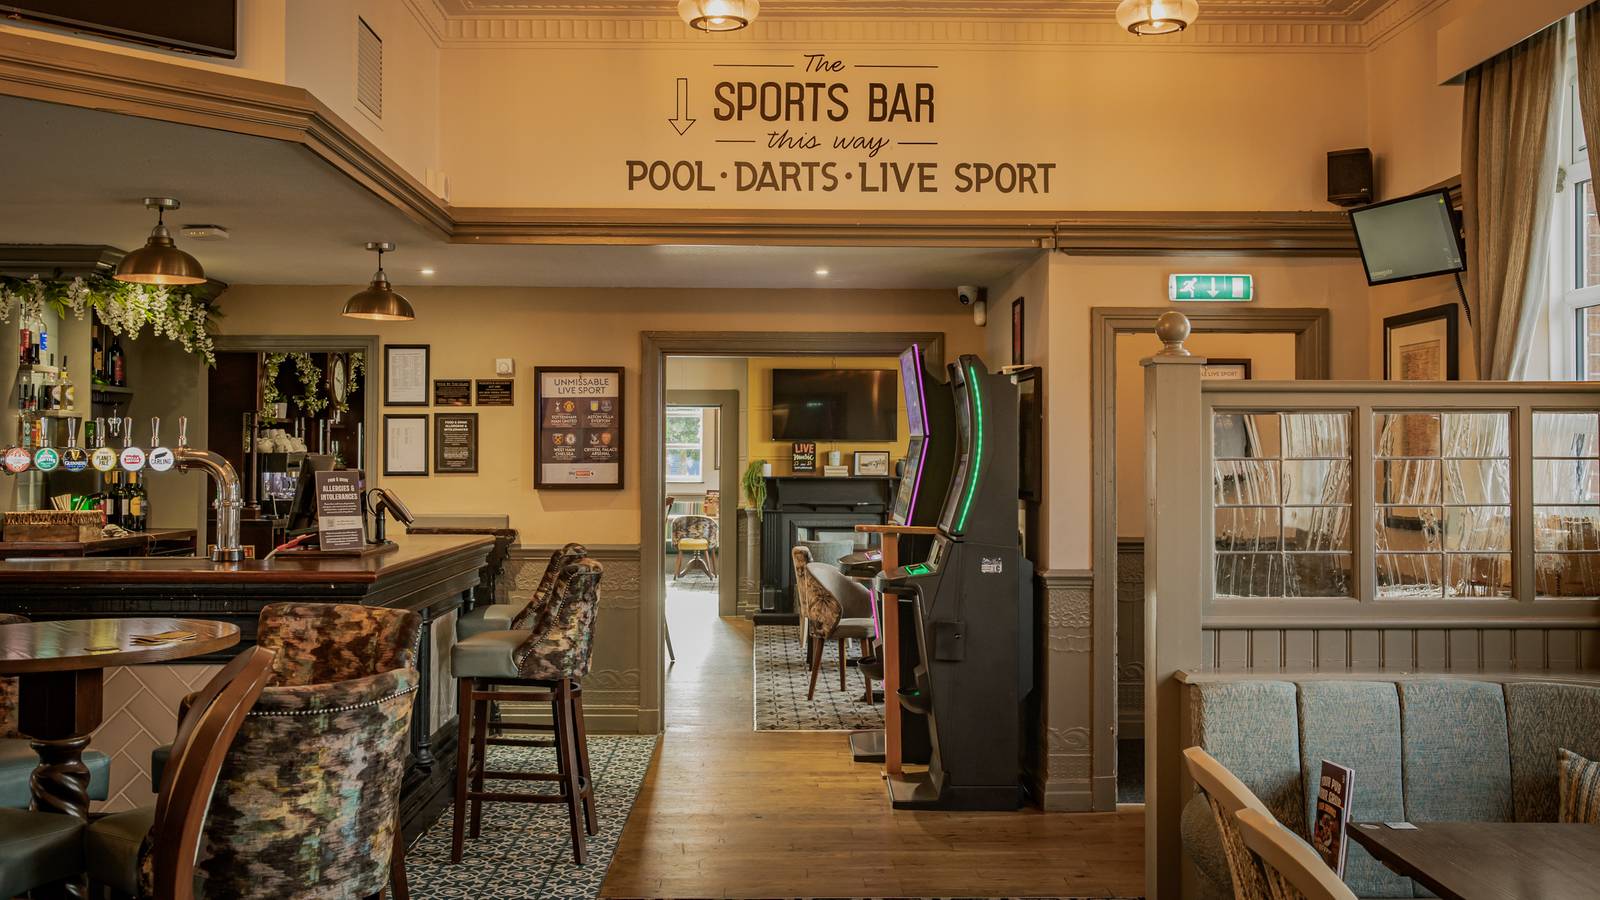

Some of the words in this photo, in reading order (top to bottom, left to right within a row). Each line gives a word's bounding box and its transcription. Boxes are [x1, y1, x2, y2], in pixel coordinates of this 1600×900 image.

[803, 54, 846, 72] The
[713, 81, 849, 122] SPORTS
[868, 82, 935, 123] BAR
[767, 130, 821, 150] this
[833, 136, 890, 158] way
[626, 160, 716, 192] POOL
[734, 161, 839, 192] DARTS
[859, 162, 938, 192] LIVE
[954, 162, 1056, 194] SPORT
[554, 378, 609, 386] UNMISSABLE
[558, 386, 576, 394] LIVE
[580, 386, 606, 394] SPORT
